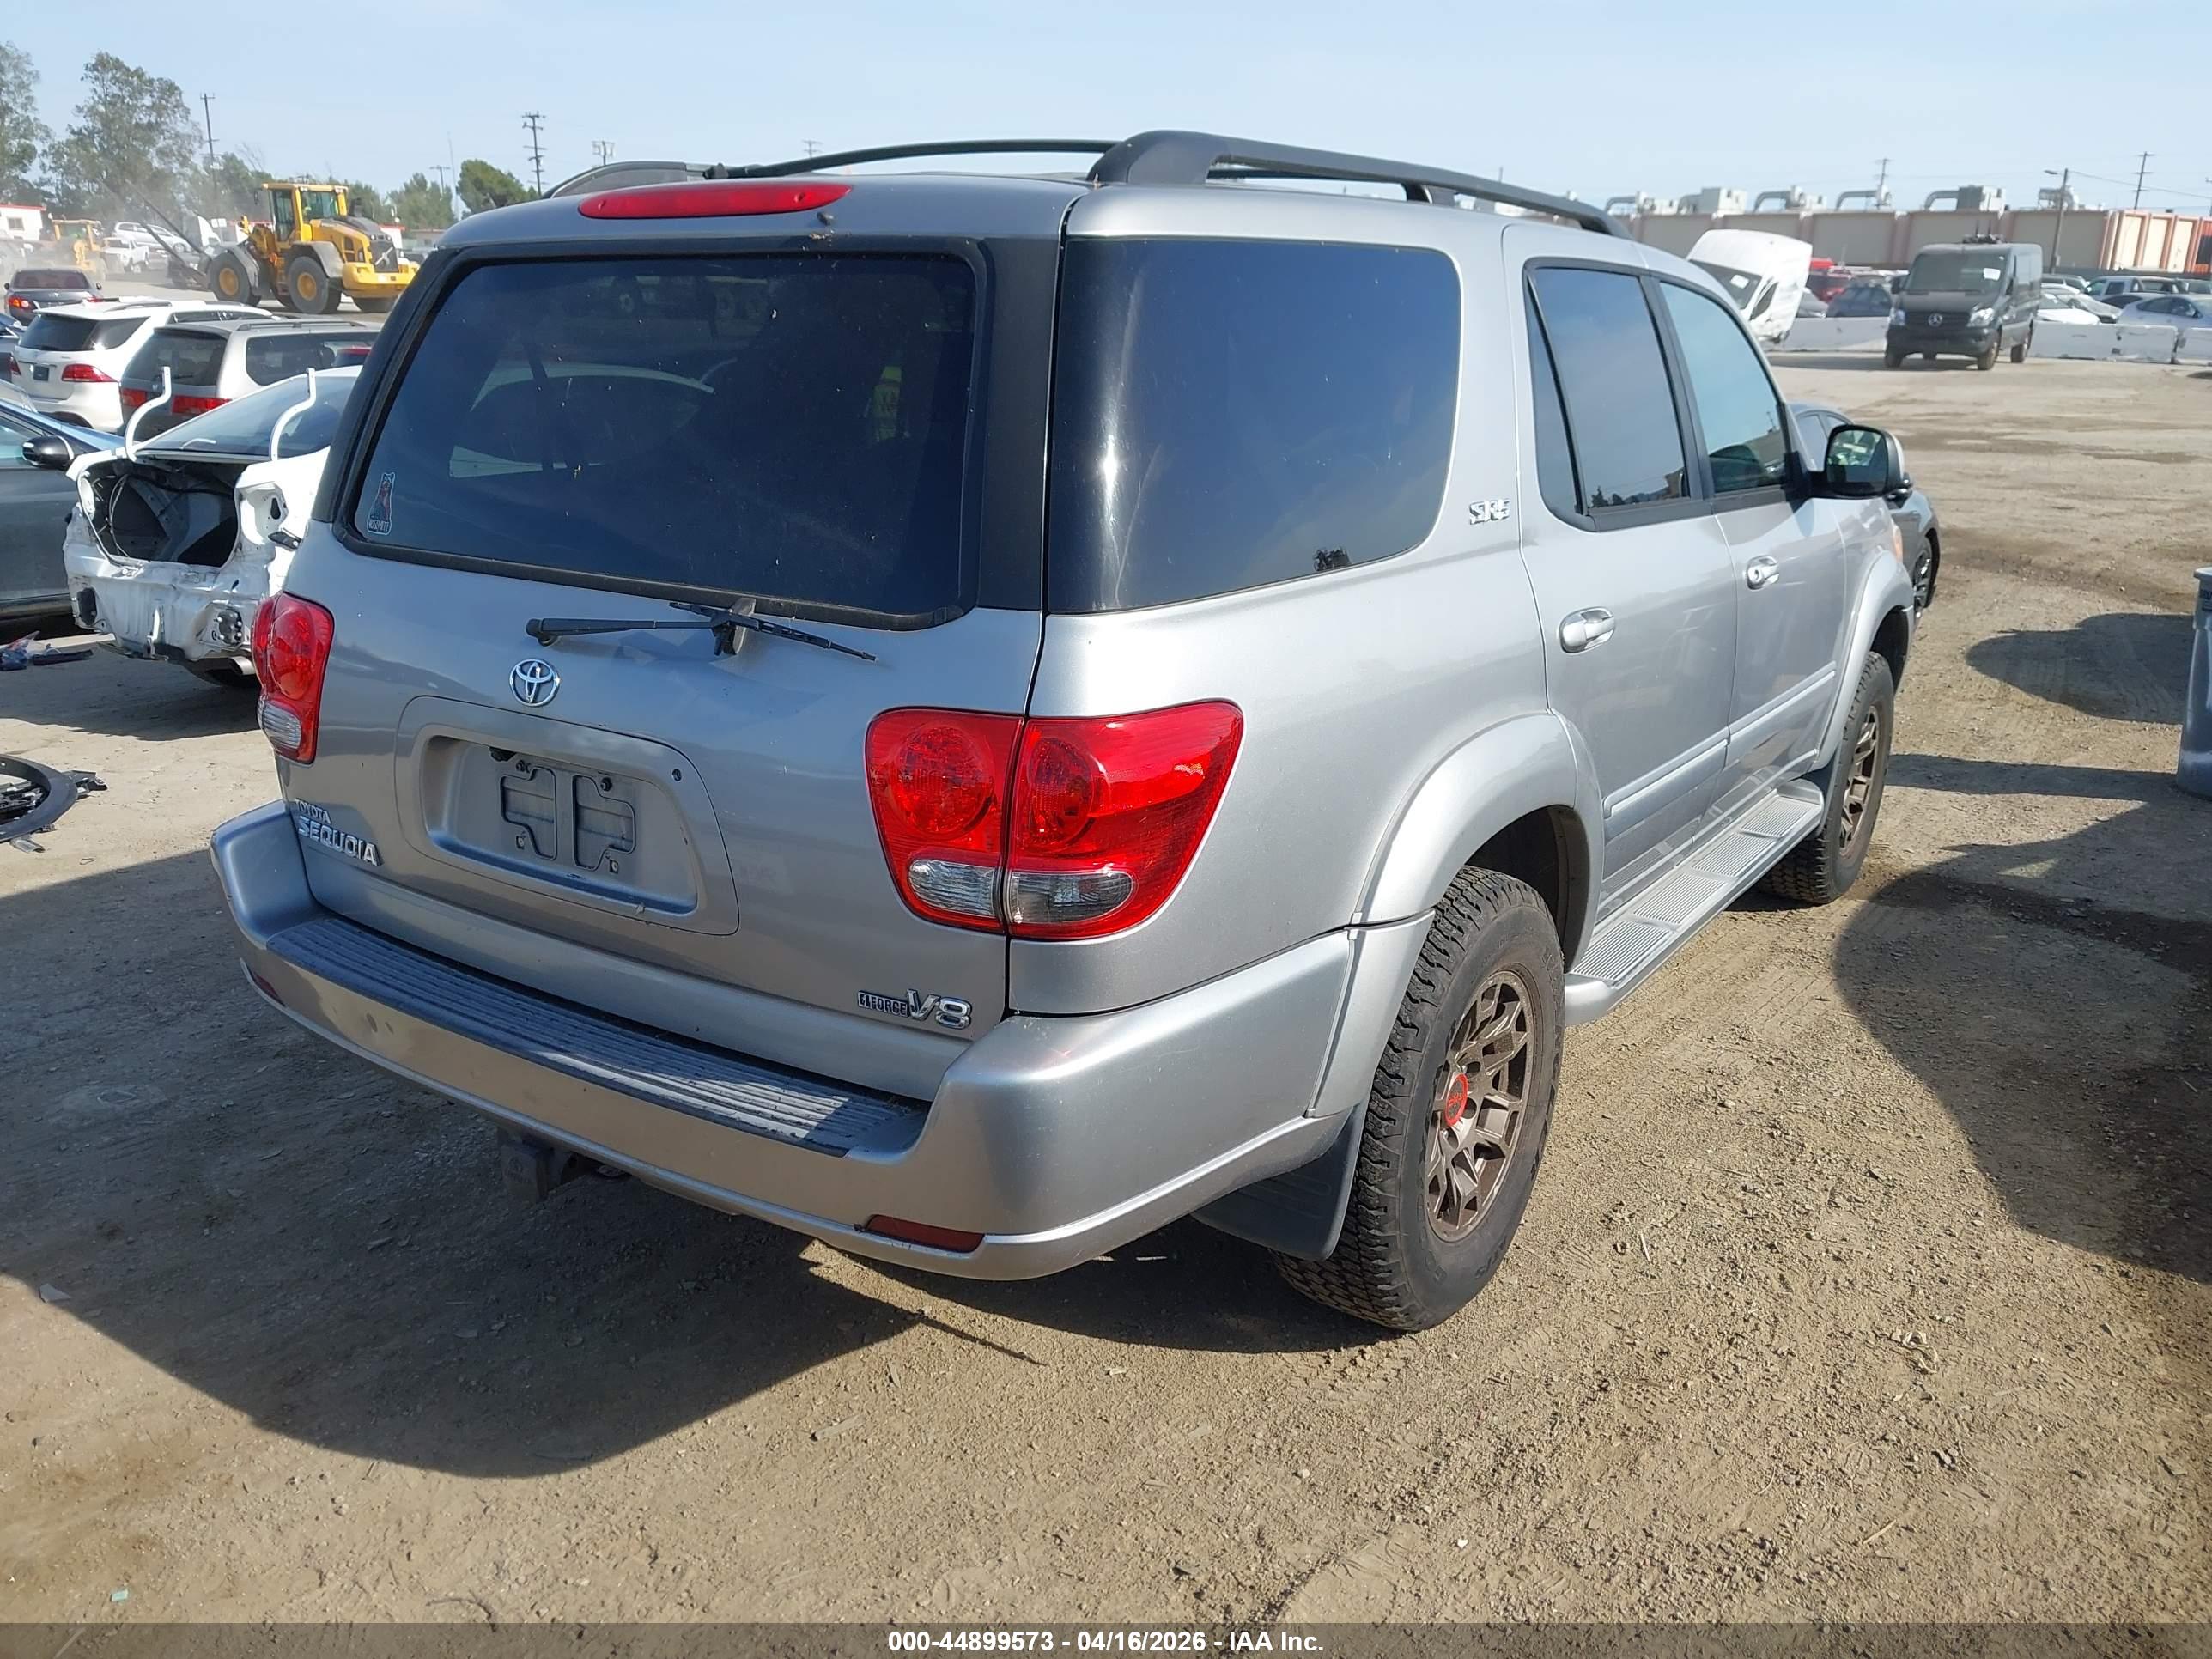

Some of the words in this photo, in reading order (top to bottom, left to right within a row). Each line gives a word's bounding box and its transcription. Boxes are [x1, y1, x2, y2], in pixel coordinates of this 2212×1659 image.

[295, 798, 331, 824] TOYOTA
[298, 815, 381, 866] SEQUOIA
[906, 988, 972, 1030] V8
